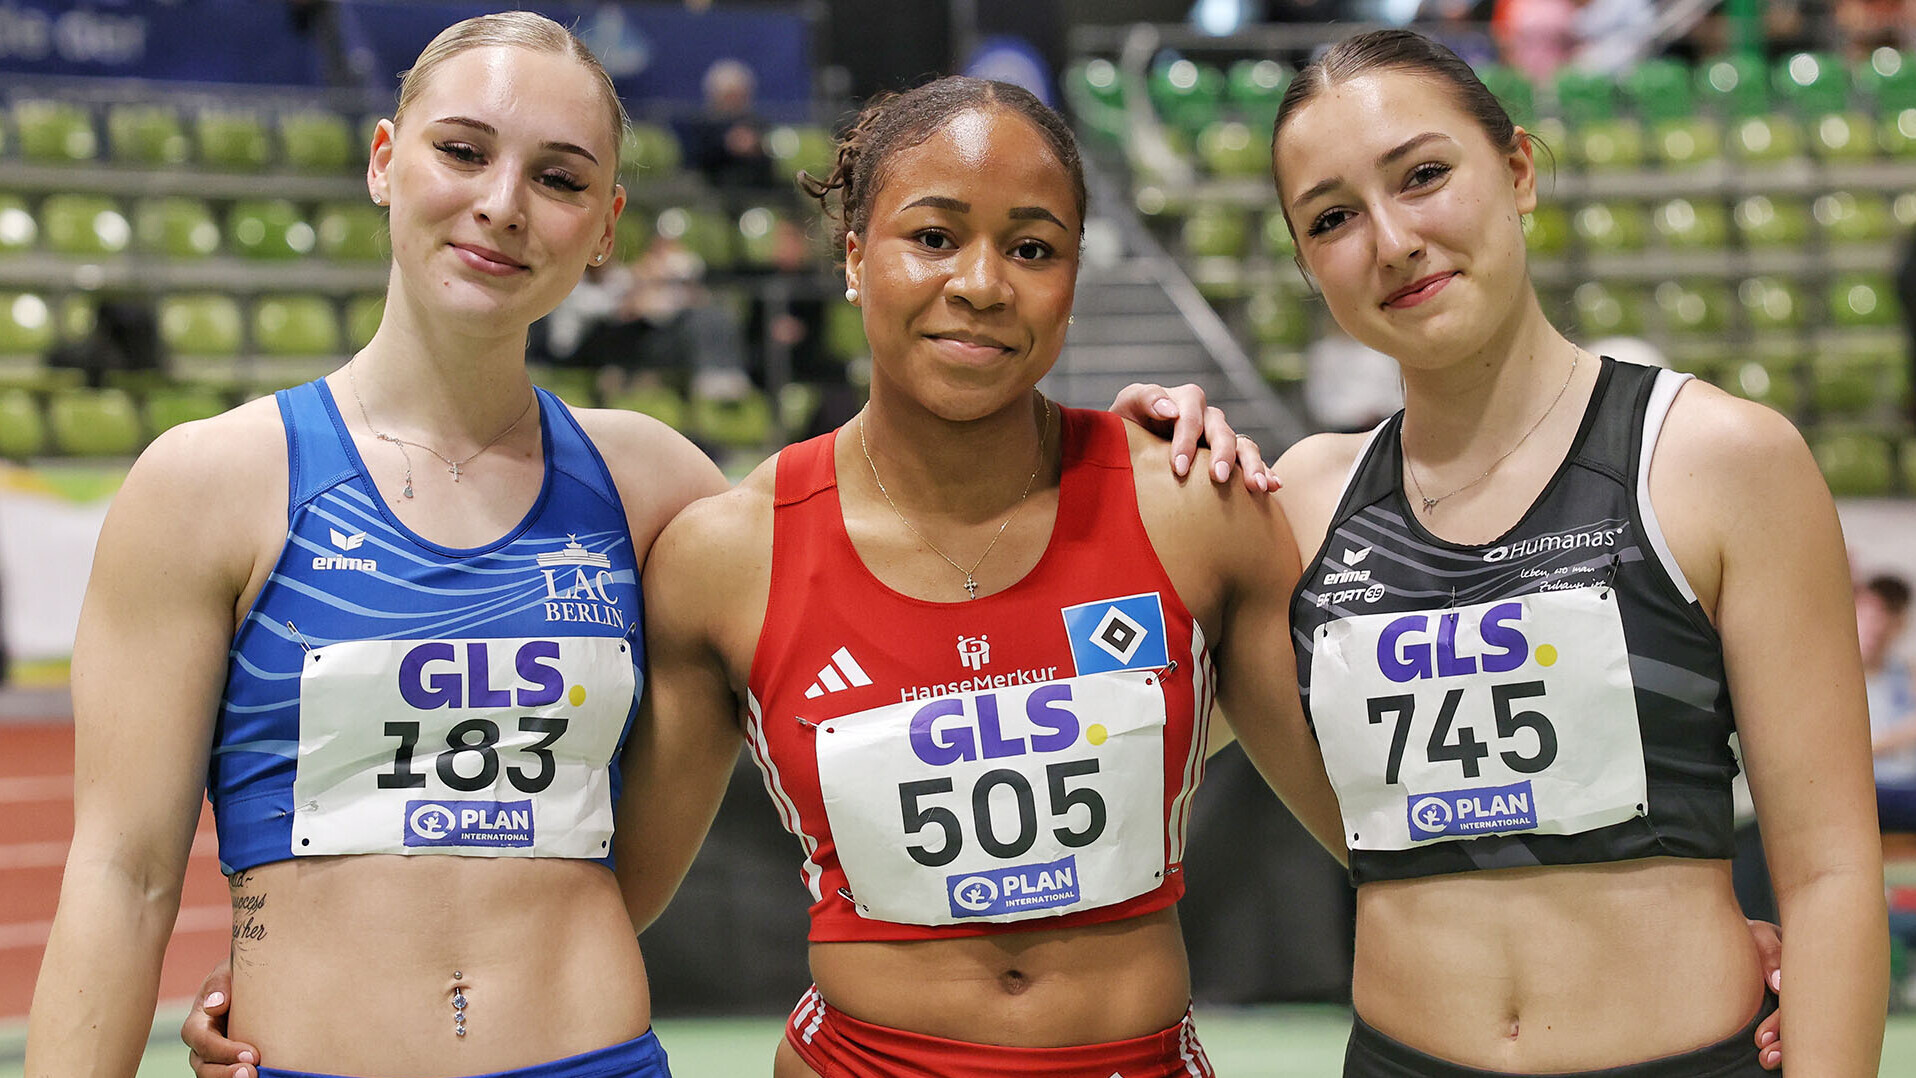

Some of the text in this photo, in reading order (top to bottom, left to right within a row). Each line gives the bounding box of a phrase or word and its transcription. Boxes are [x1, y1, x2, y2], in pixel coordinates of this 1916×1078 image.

[1509, 530, 1615, 560] Humanas
[312, 554, 377, 571] erima
[540, 568, 618, 605] LAC
[1323, 569, 1371, 585] erima
[544, 602, 624, 629] BERLIN
[900, 665, 1058, 702] HanseMerkur
[1366, 680, 1558, 785] 745
[376, 717, 570, 794] 183
[461, 809, 529, 830] PLAN
[898, 758, 1107, 867] 505
[1456, 792, 1529, 820] PLAN
[461, 833, 529, 841] INTERNATIONAL
[1460, 817, 1531, 830] INTERNATIONAL
[1002, 867, 1073, 897] PLAN
[1005, 891, 1075, 908] INTERNATIONAL
[241, 916, 268, 941] her
